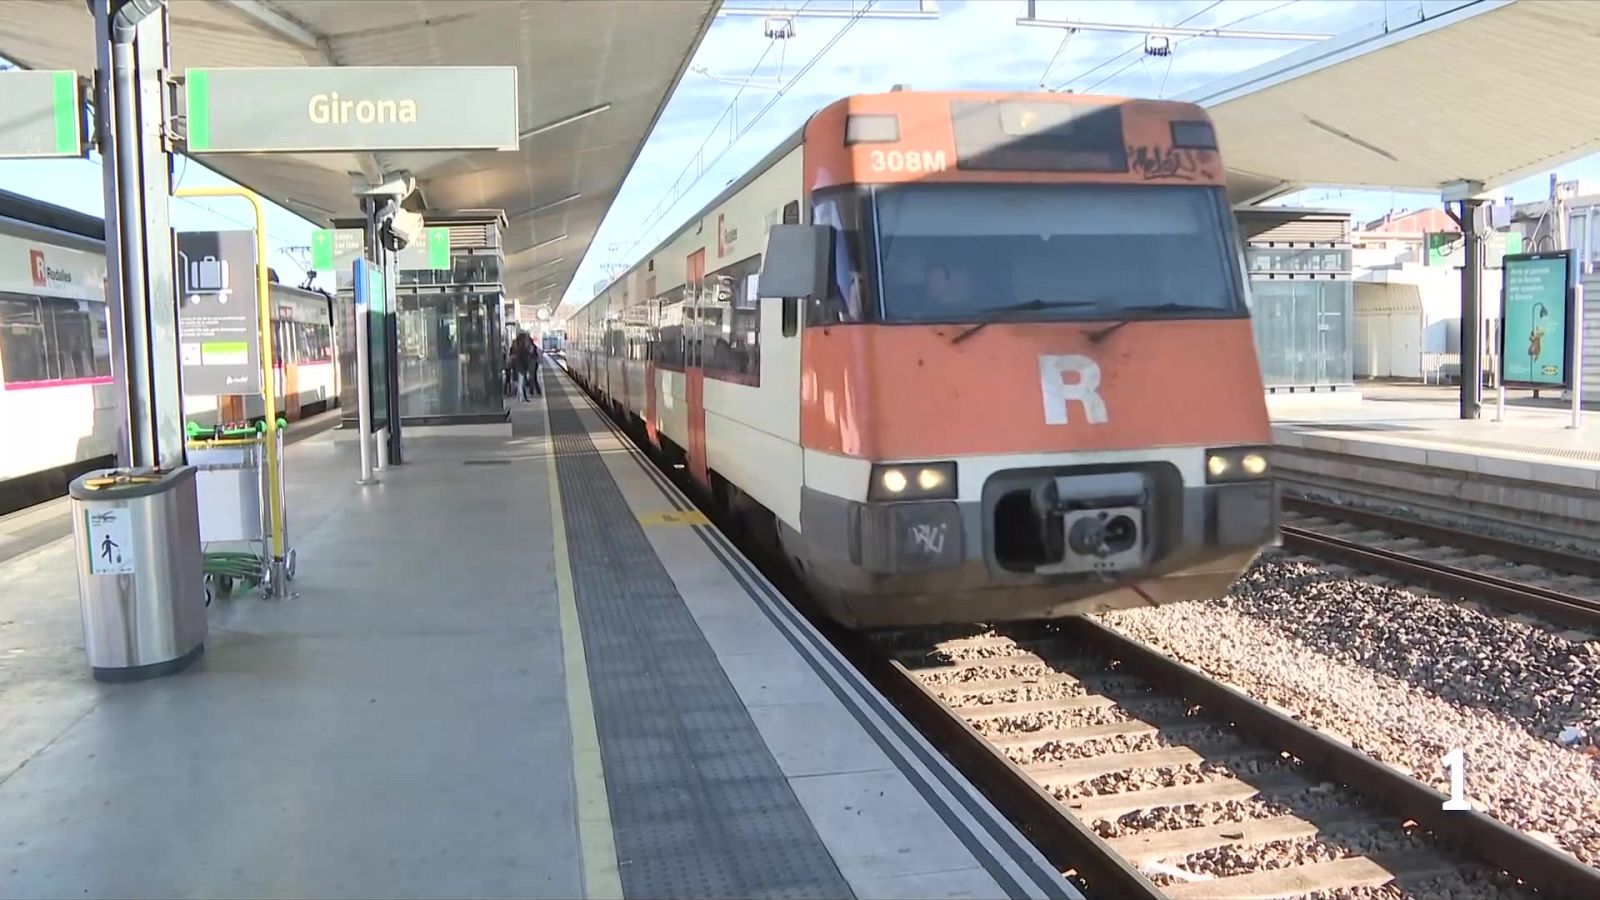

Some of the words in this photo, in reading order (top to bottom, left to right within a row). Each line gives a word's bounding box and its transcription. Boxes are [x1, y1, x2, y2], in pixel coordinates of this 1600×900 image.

[308, 91, 417, 124] Girona
[870, 149, 946, 173] 308M
[1038, 354, 1109, 425] R
